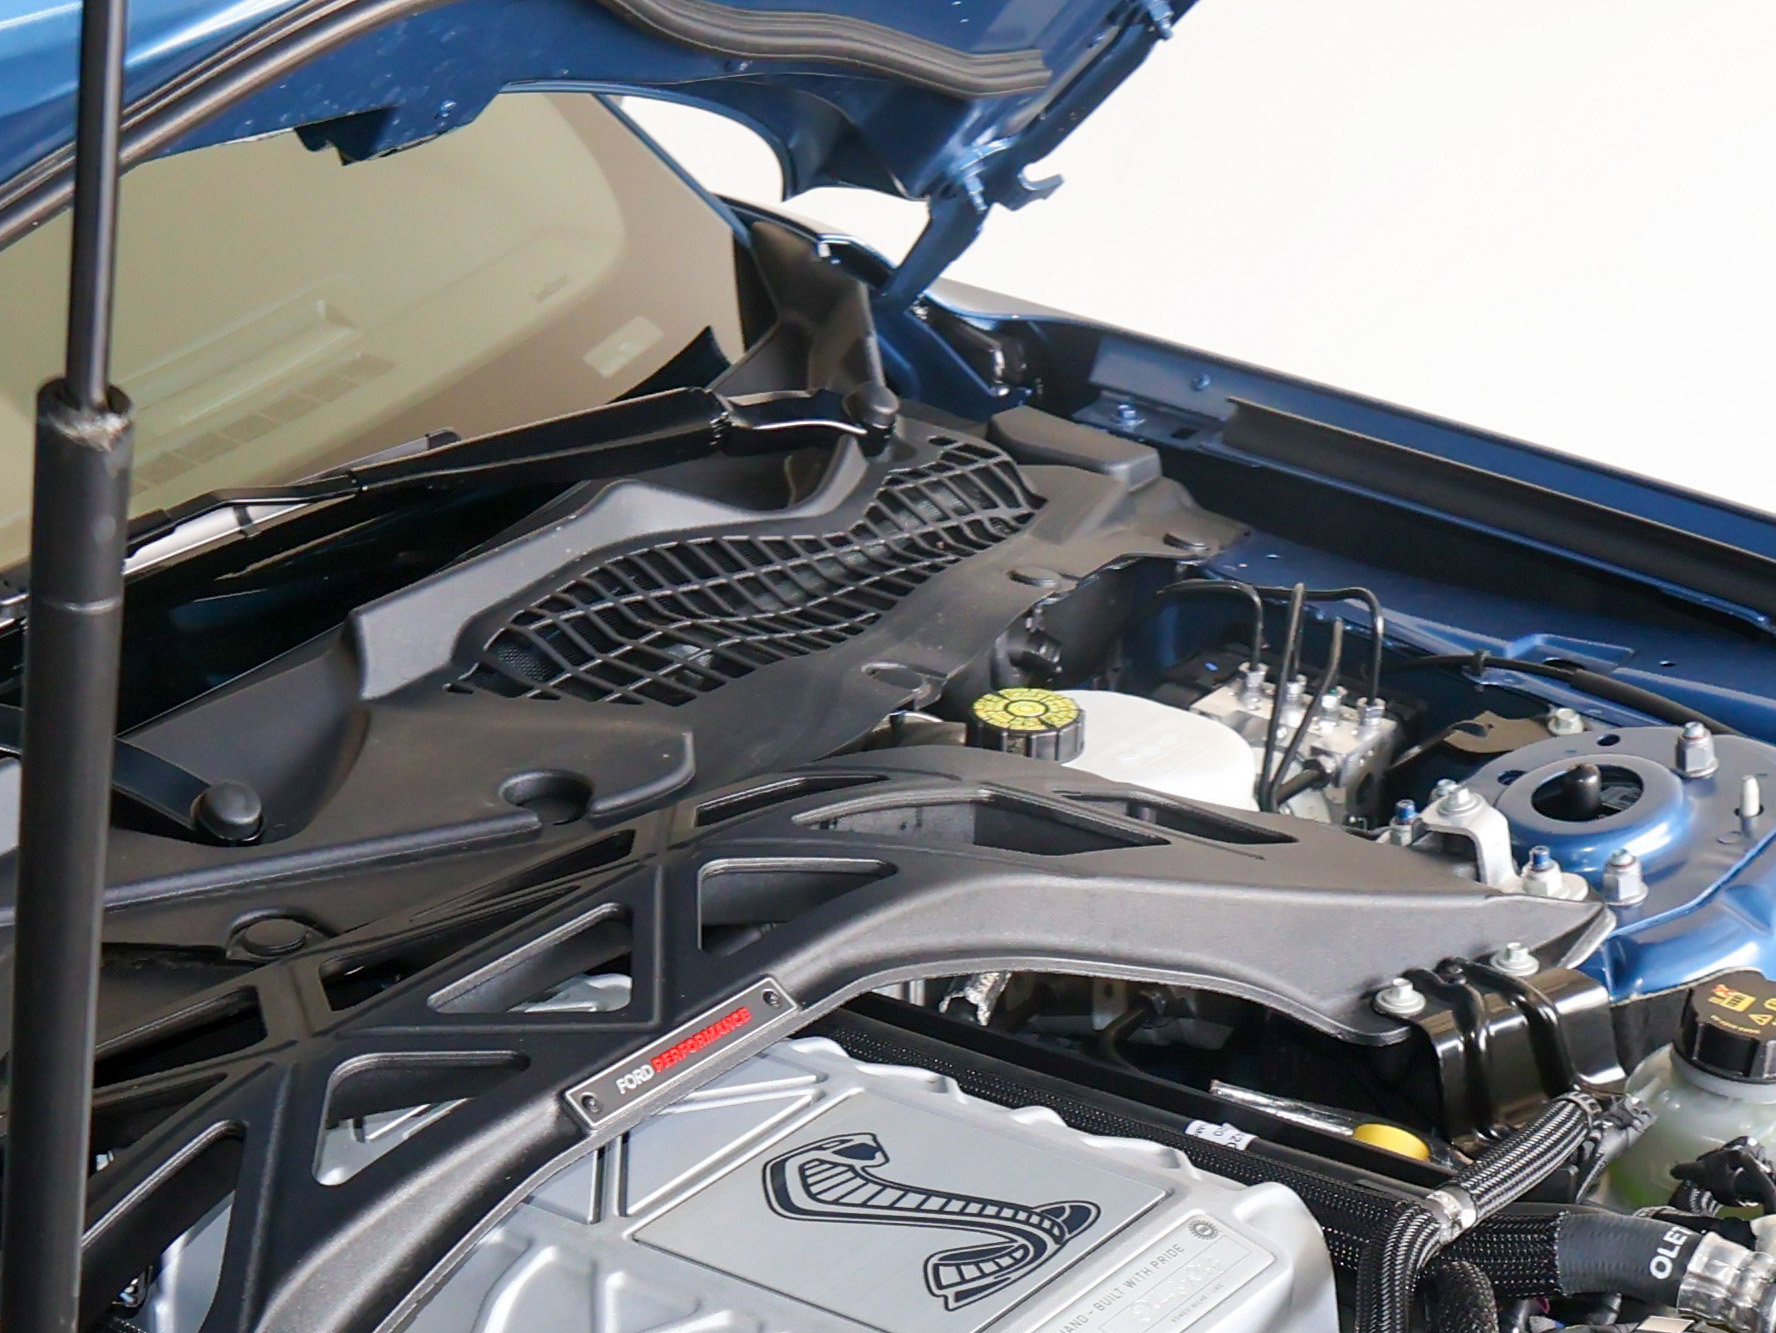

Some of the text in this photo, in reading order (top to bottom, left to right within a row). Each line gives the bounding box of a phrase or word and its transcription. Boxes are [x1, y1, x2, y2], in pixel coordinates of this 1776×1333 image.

[615, 1006, 753, 1094] FORD PERFORMANCE
[1124, 1267, 1152, 1289] WITH
[1152, 1243, 1186, 1269] PRIDE
